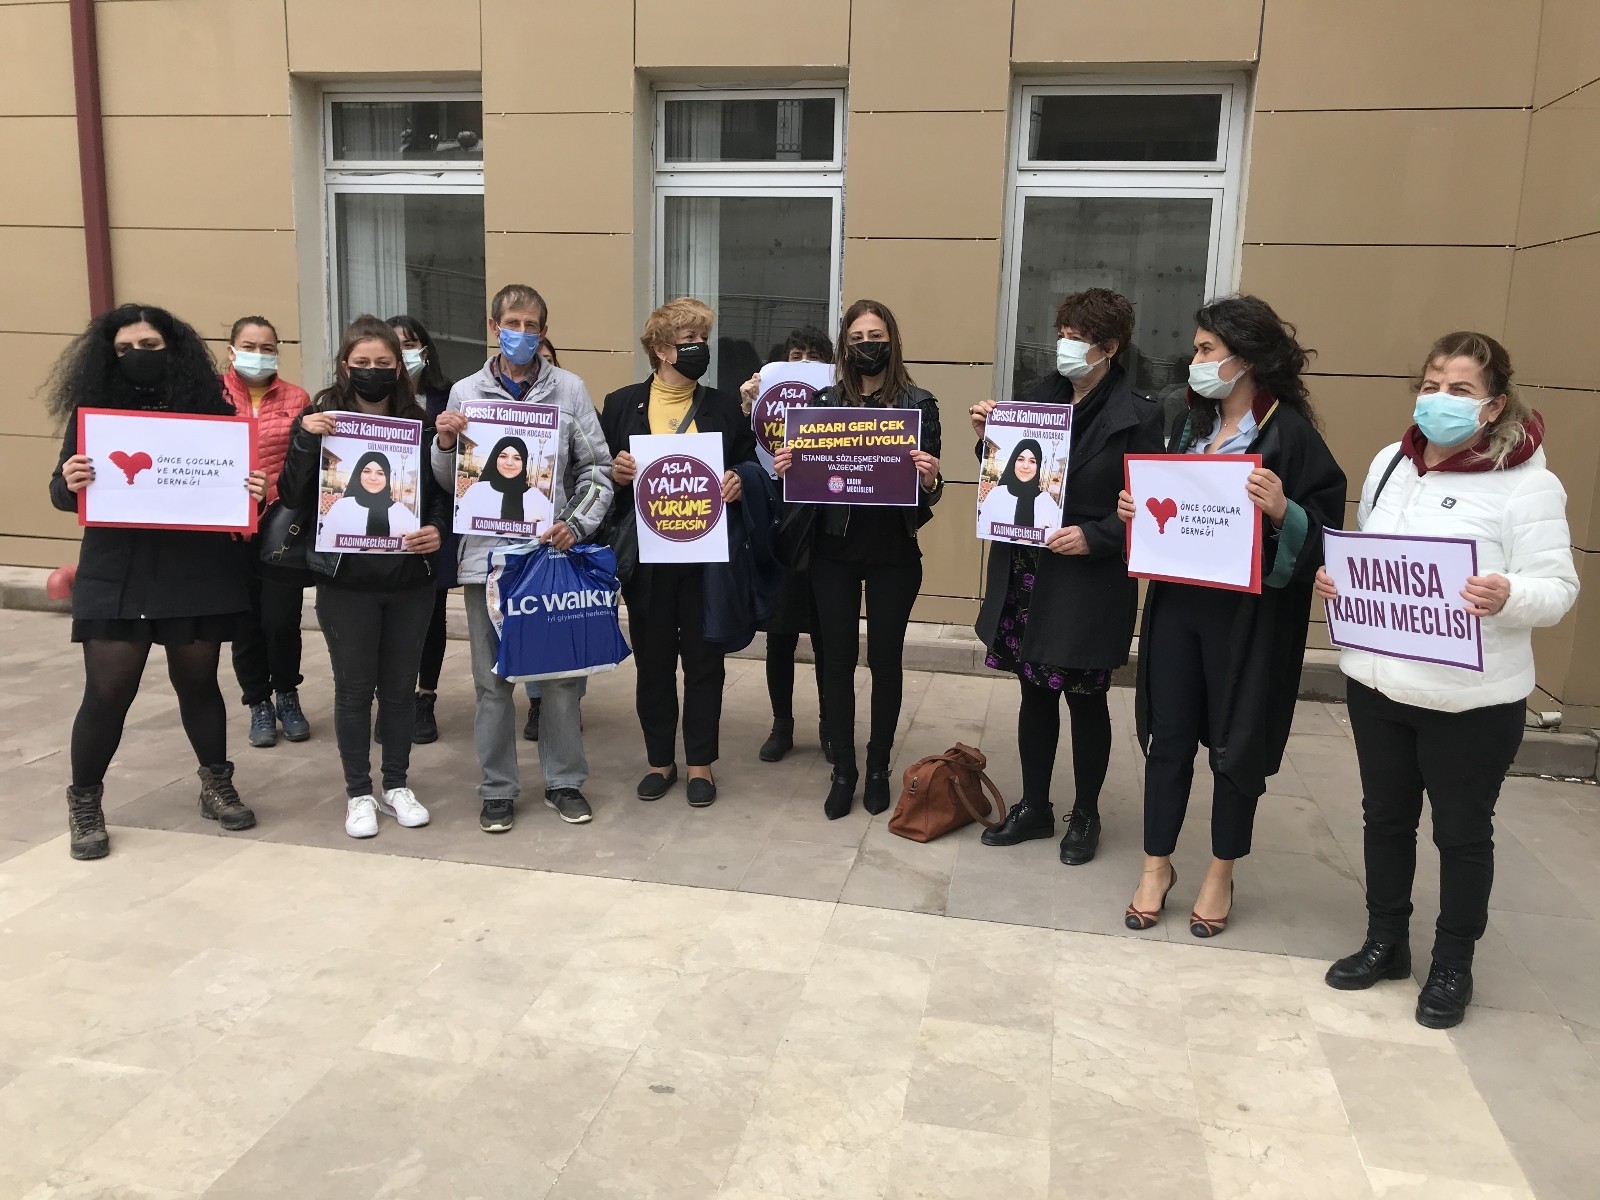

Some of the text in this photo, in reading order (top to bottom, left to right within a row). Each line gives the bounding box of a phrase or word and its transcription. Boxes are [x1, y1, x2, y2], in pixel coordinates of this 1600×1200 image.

[780, 388, 806, 400] ASLA
[465, 406, 495, 420] Sessiz
[991, 408, 1016, 422] Sessiz
[334, 420, 360, 435] essiz
[800, 419, 905, 434] KARARI GERİ ÇEK
[787, 434, 916, 449] SÖZLEŞMEYİ UYGULA
[157, 454, 235, 468] ÖNCE ÇOCUKLAR
[801, 453, 834, 462] İSTANBUL
[172, 468, 220, 477] KADINLAR
[661, 461, 692, 475] ASLA
[827, 463, 874, 473] VAZGEÇMEYİZ
[157, 476, 201, 487] DERNEĞİ
[647, 476, 709, 496] YALNIZ
[648, 495, 712, 518] YÜRÜME
[1180, 500, 1241, 516] ÖNCE ÇOCUKLAR
[655, 517, 707, 531] YECEKSİN
[1180, 515, 1189, 523] VE
[1180, 525, 1215, 537] DERNEĞİ
[1346, 554, 1445, 599] MANİSA
[507, 595, 539, 616] LC
[1332, 595, 1387, 629] KADIN
